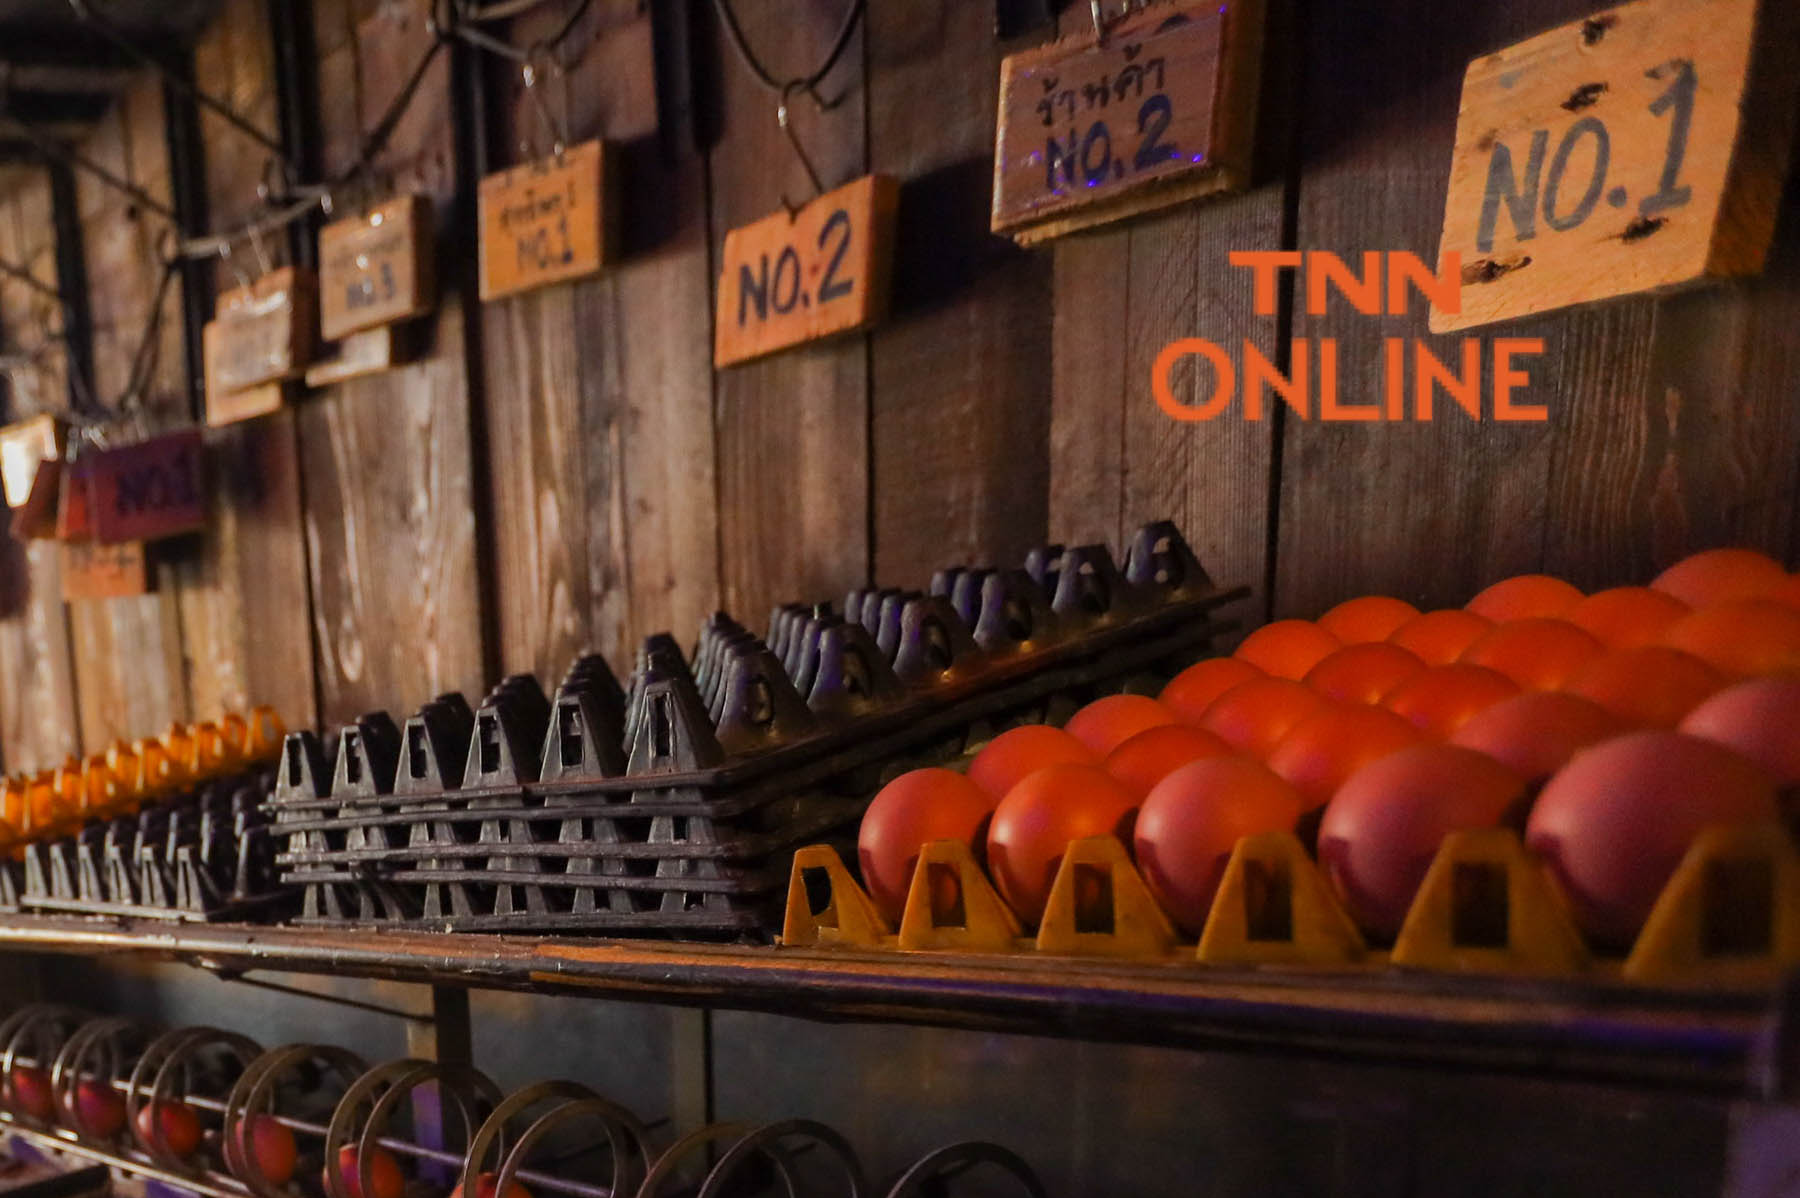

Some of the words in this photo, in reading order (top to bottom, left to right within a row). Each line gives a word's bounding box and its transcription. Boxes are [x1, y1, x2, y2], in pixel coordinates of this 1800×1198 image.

[1046, 95, 1179, 192] NO.2
[1476, 58, 1698, 253] NO.1
[738, 209, 855, 328] NO.2
